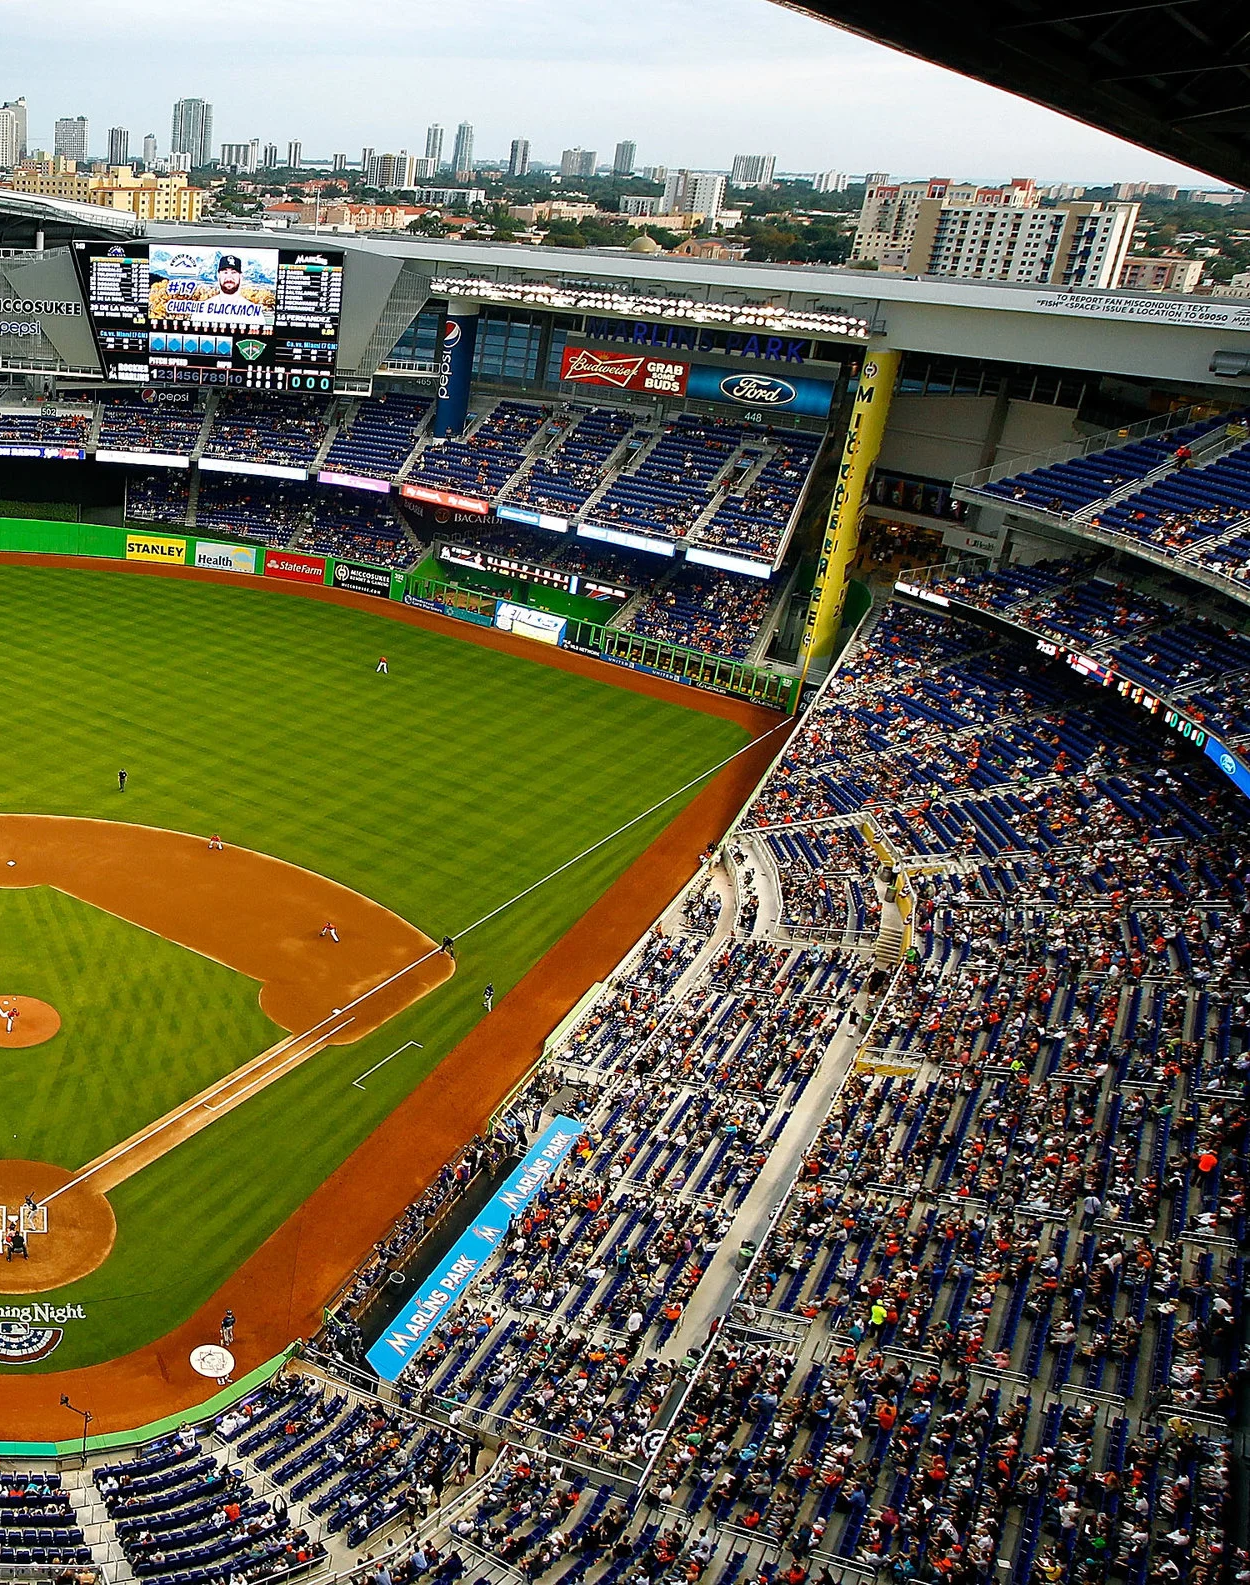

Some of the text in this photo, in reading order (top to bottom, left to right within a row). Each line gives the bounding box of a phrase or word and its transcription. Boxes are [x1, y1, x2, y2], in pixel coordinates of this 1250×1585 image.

[168, 282, 196, 295] #19
[167, 300, 262, 316] CHARLIE BLACKMON
[1036, 299, 1064, 308] "FISH"
[1064, 301, 1100, 311] <SPACE>
[1102, 305, 1127, 314] ISSUE
[1136, 308, 1182, 318] LOCATION
[1184, 311, 1198, 319] TO
[1198, 312, 1228, 322] 69050
[1056, 294, 1211, 313] TO REPORT FAN MISCONDUCT: TEXT
[286, 314, 331, 323] FERNANDEZ
[586, 316, 806, 364] MARLINS PARK
[568, 354, 639, 376] Budweiser
[646, 362, 684, 376] GRAB
[438, 350, 453, 400] pepsi
[651, 372, 676, 382] SOME
[292, 376, 330, 390] 0 0 0
[644, 377, 680, 392] BUDS
[732, 378, 782, 402] Ford
[158, 393, 190, 404] pepsi
[42, 408, 56, 416] 502
[744, 412, 762, 422] 448
[454, 512, 504, 525] BACARDI
[127, 542, 184, 558] STANLEY
[198, 554, 233, 568] Health
[349, 576, 366, 584] RESORT
[350, 570, 390, 583] MICCOSUKEE
[579, 646, 600, 657] NETWORK
[608, 657, 630, 668] UNITED
[652, 669, 674, 680] UNITED
[498, 1130, 574, 1212] MARLINS PARK
[384, 1253, 479, 1358] MARLINS PARK
[31, 1302, 86, 1324] Night
